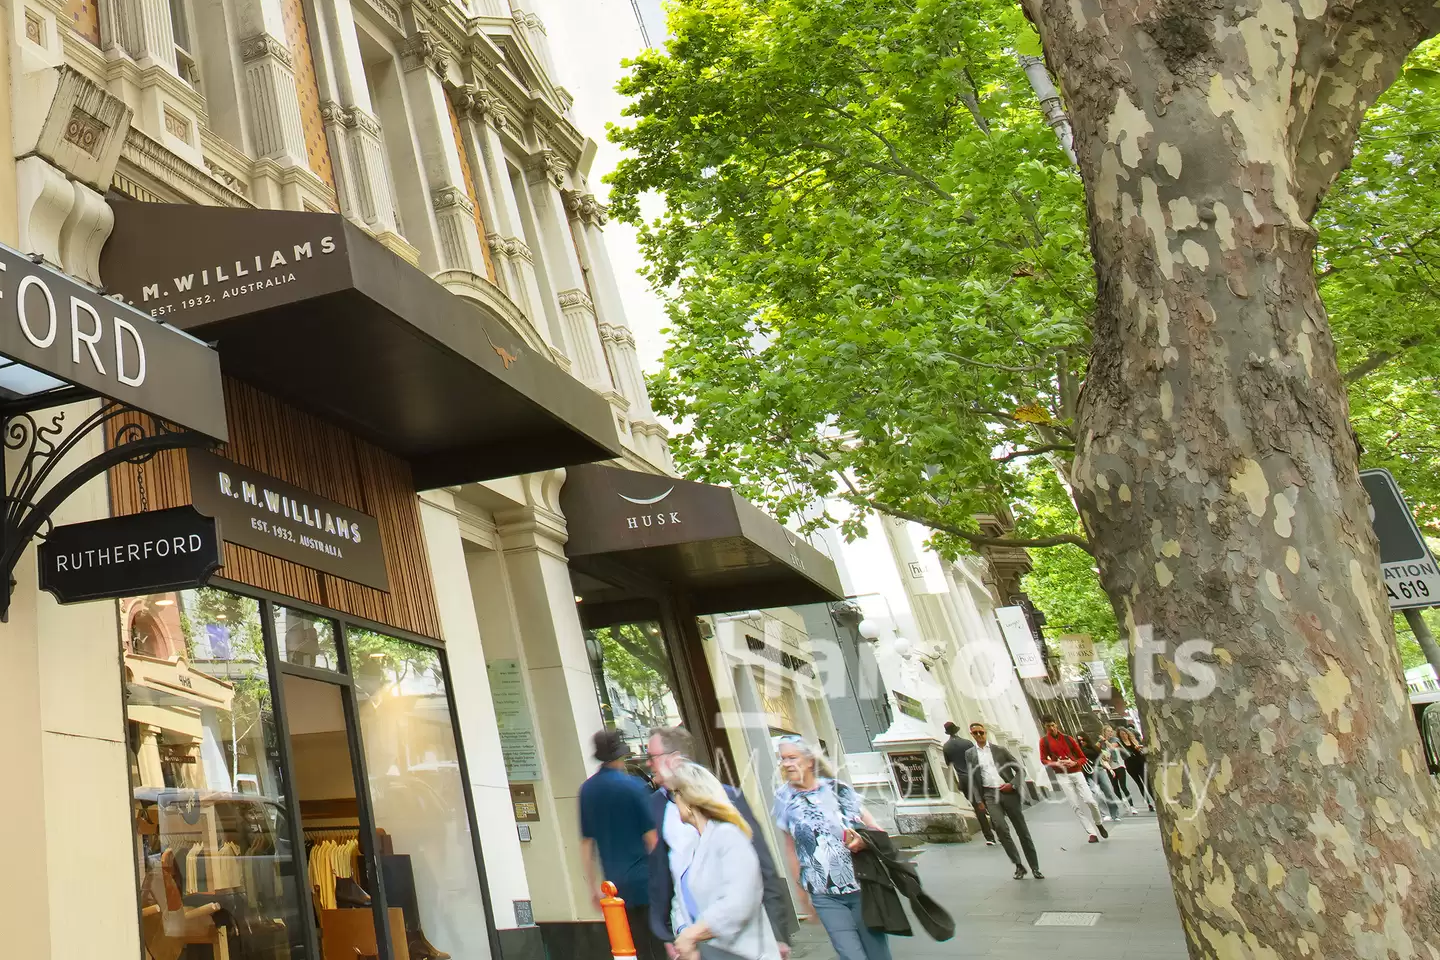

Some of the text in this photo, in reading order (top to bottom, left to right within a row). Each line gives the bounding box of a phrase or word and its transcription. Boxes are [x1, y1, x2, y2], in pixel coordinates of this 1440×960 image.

[150, 304, 177, 317] EST.
[221, 272, 297, 300] AUSTRALIA
[626, 511, 682, 529] HUSK
[56, 532, 203, 573] RUTHERFORD
[250, 517, 271, 534] EST.
[299, 534, 344, 559] AUSTRALIA
[1384, 564, 1433, 579] ATION
[1400, 580, 1429, 598] 619
